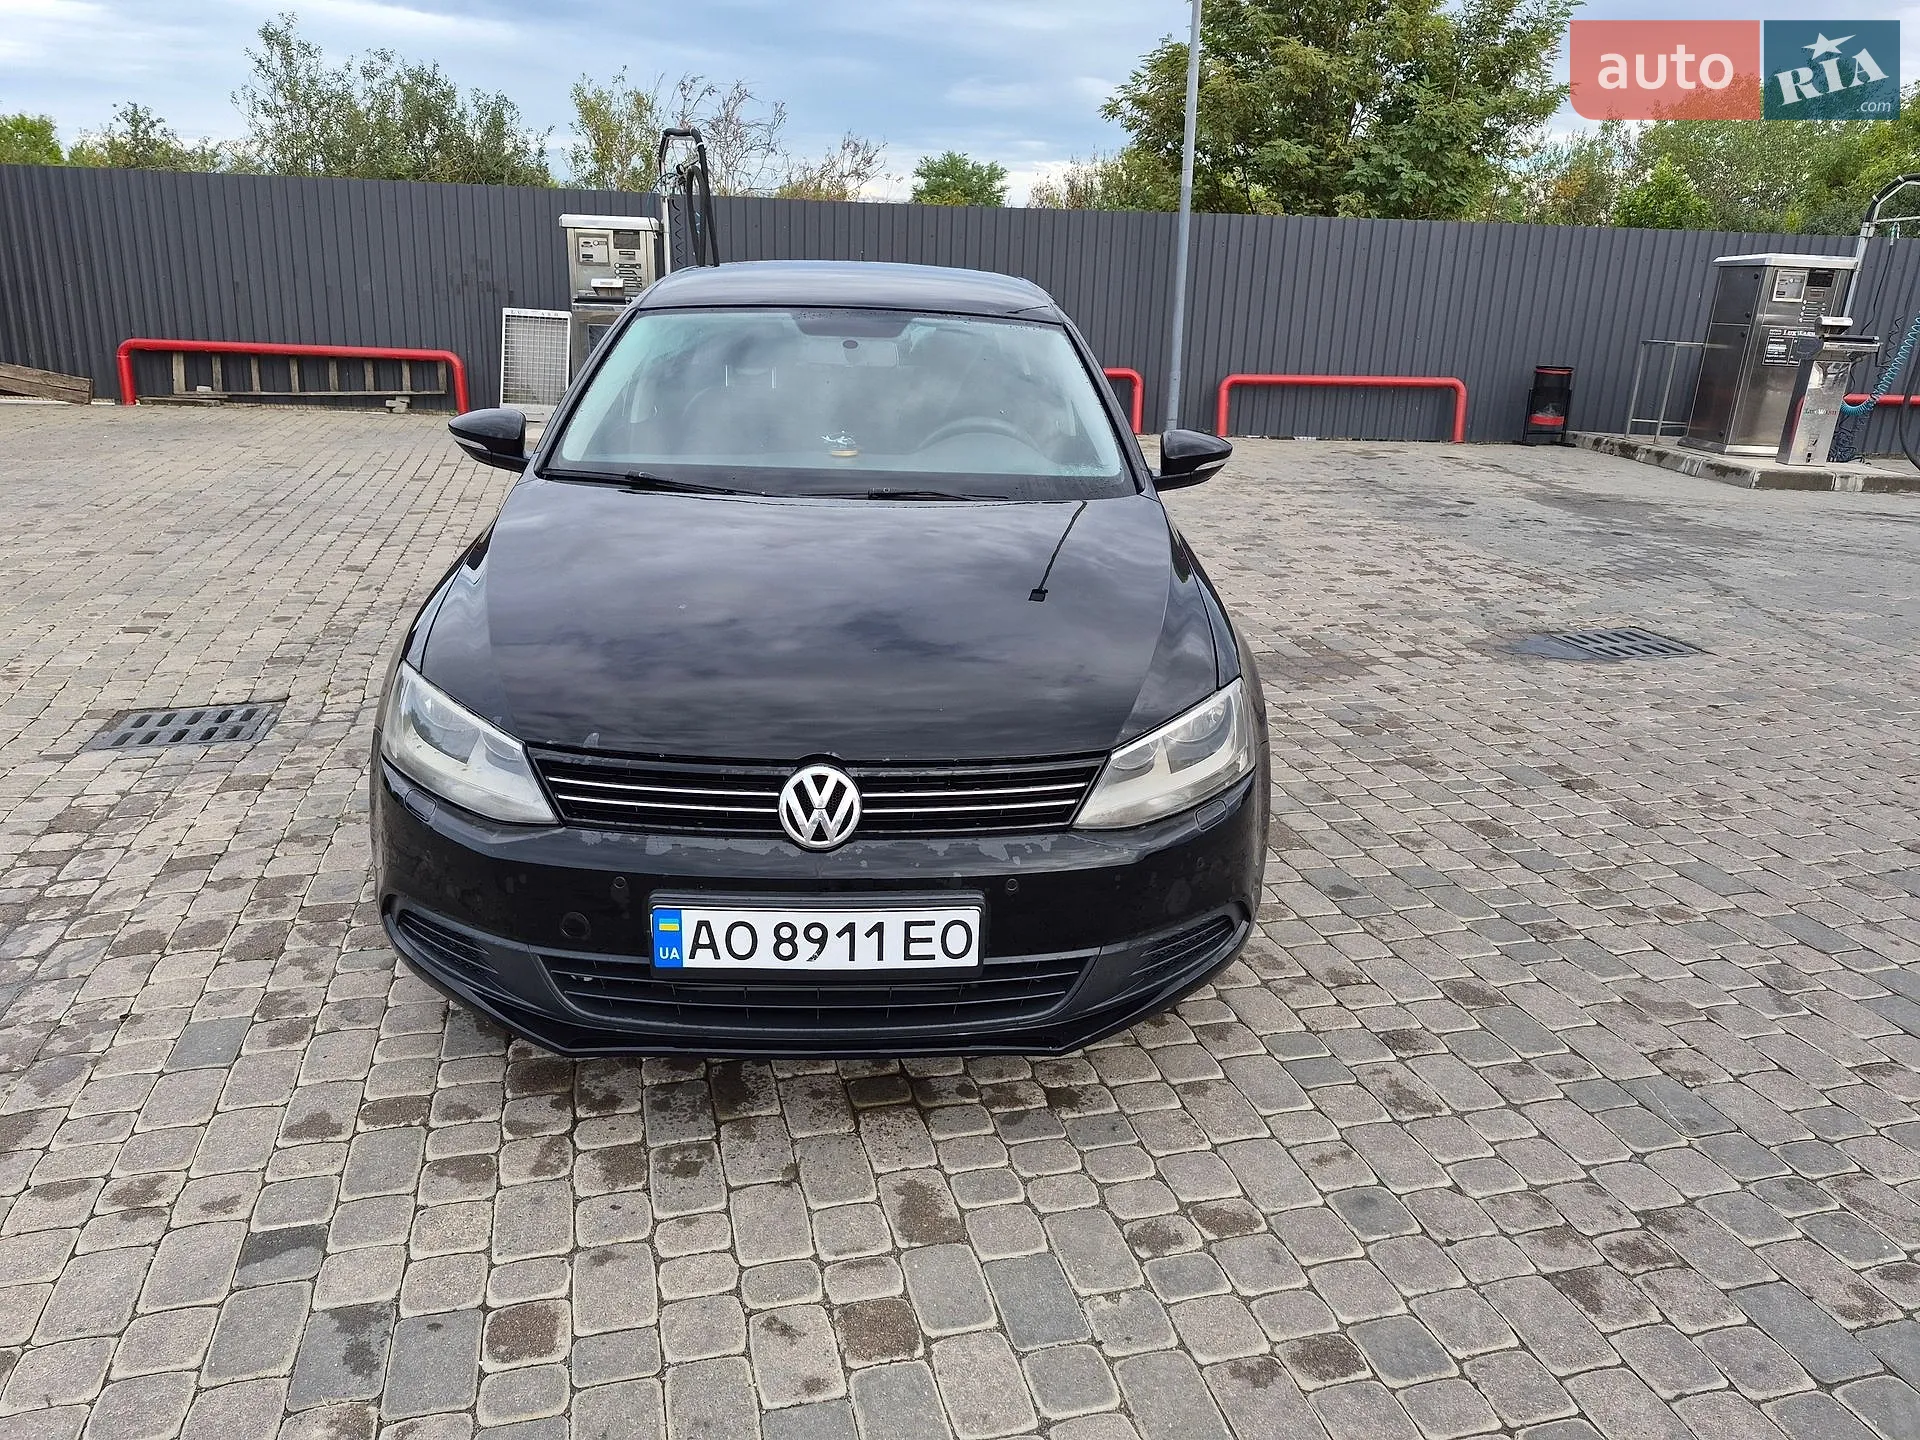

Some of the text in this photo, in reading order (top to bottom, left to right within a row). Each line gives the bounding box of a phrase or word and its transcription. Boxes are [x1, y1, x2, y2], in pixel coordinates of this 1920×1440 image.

[659, 947, 680, 961] UA
[688, 920, 973, 962] AO 8911 EO
